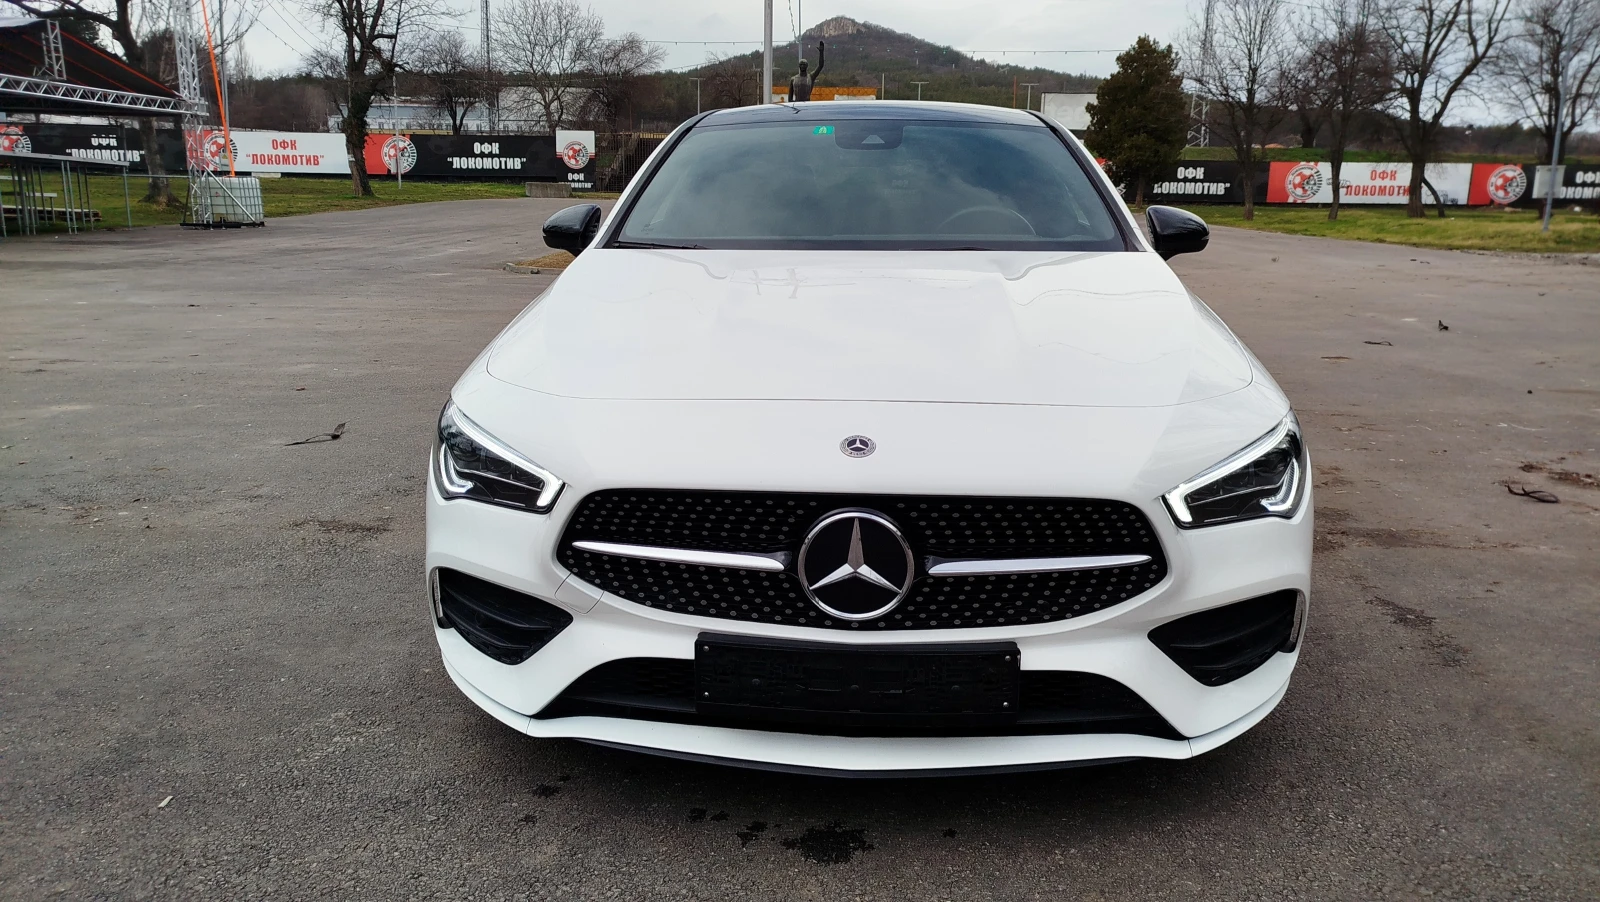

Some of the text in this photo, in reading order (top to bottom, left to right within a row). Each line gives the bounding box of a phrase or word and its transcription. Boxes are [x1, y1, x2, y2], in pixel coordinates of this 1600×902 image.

[271, 138, 297, 151] ОФК
[473, 142, 499, 154] ОФК
[245, 153, 325, 166] “ЛОКОМОТИВ”
[447, 157, 526, 170] “ЛОКОМОТИВ”
[567, 172, 585, 181] ОФК
[1177, 166, 1205, 179] ОФК
[1370, 169, 1398, 181] ОФК
[1152, 181, 1231, 195] ЛОКОМОТИВ”
